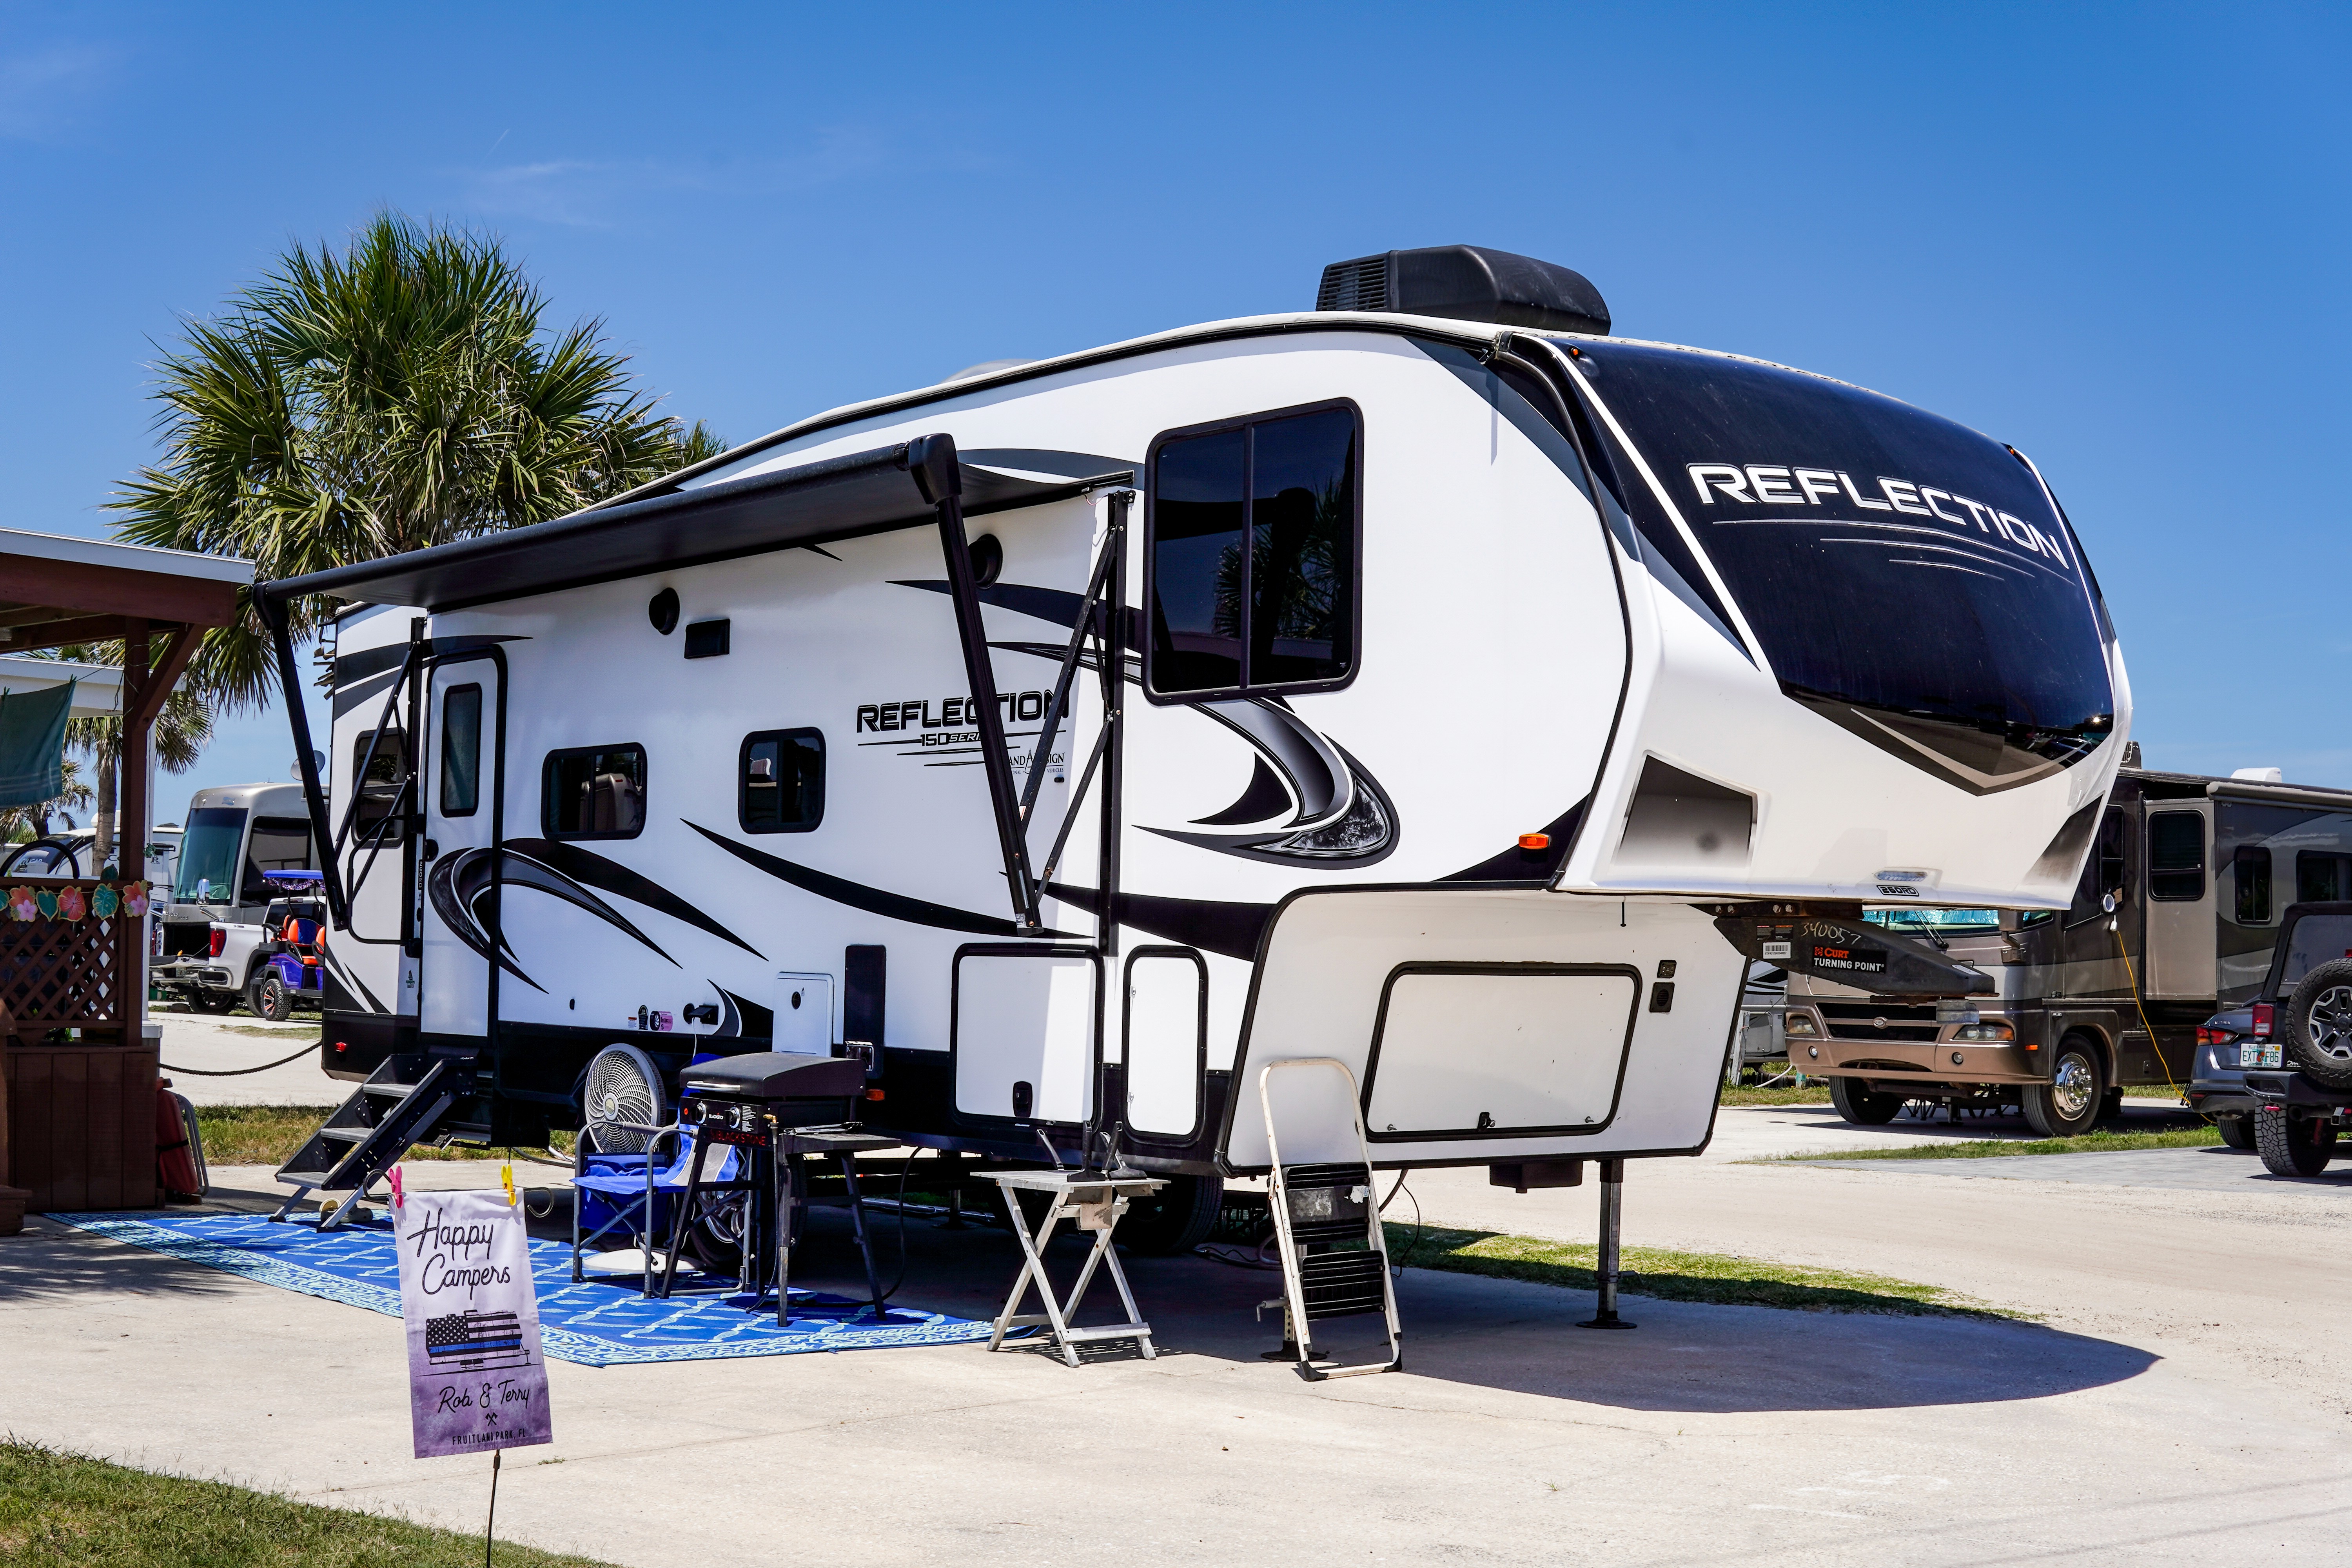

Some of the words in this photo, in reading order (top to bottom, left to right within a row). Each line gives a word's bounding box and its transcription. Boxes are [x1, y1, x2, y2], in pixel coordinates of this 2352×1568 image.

[1686, 463, 2069, 569] REFLECTION
[920, 732, 949, 747] 150
[949, 733, 981, 742] SERI
[1009, 755, 1025, 766] AND
[1047, 753, 1064, 764] IGN
[1813, 958, 1853, 969] TURNING
[2243, 1050, 2257, 1062] EXT
[2265, 1051, 2279, 1062] F86
[717, 1130, 766, 1146] BLACKSTONE
[407, 1207, 494, 1261] Happy
[422, 1253, 510, 1301] Campers
[437, 1386, 473, 1414] Rob
[479, 1382, 492, 1408] &
[497, 1379, 530, 1409] Terry
[495, 1429, 516, 1441] PARK,
[519, 1428, 526, 1437] FL
